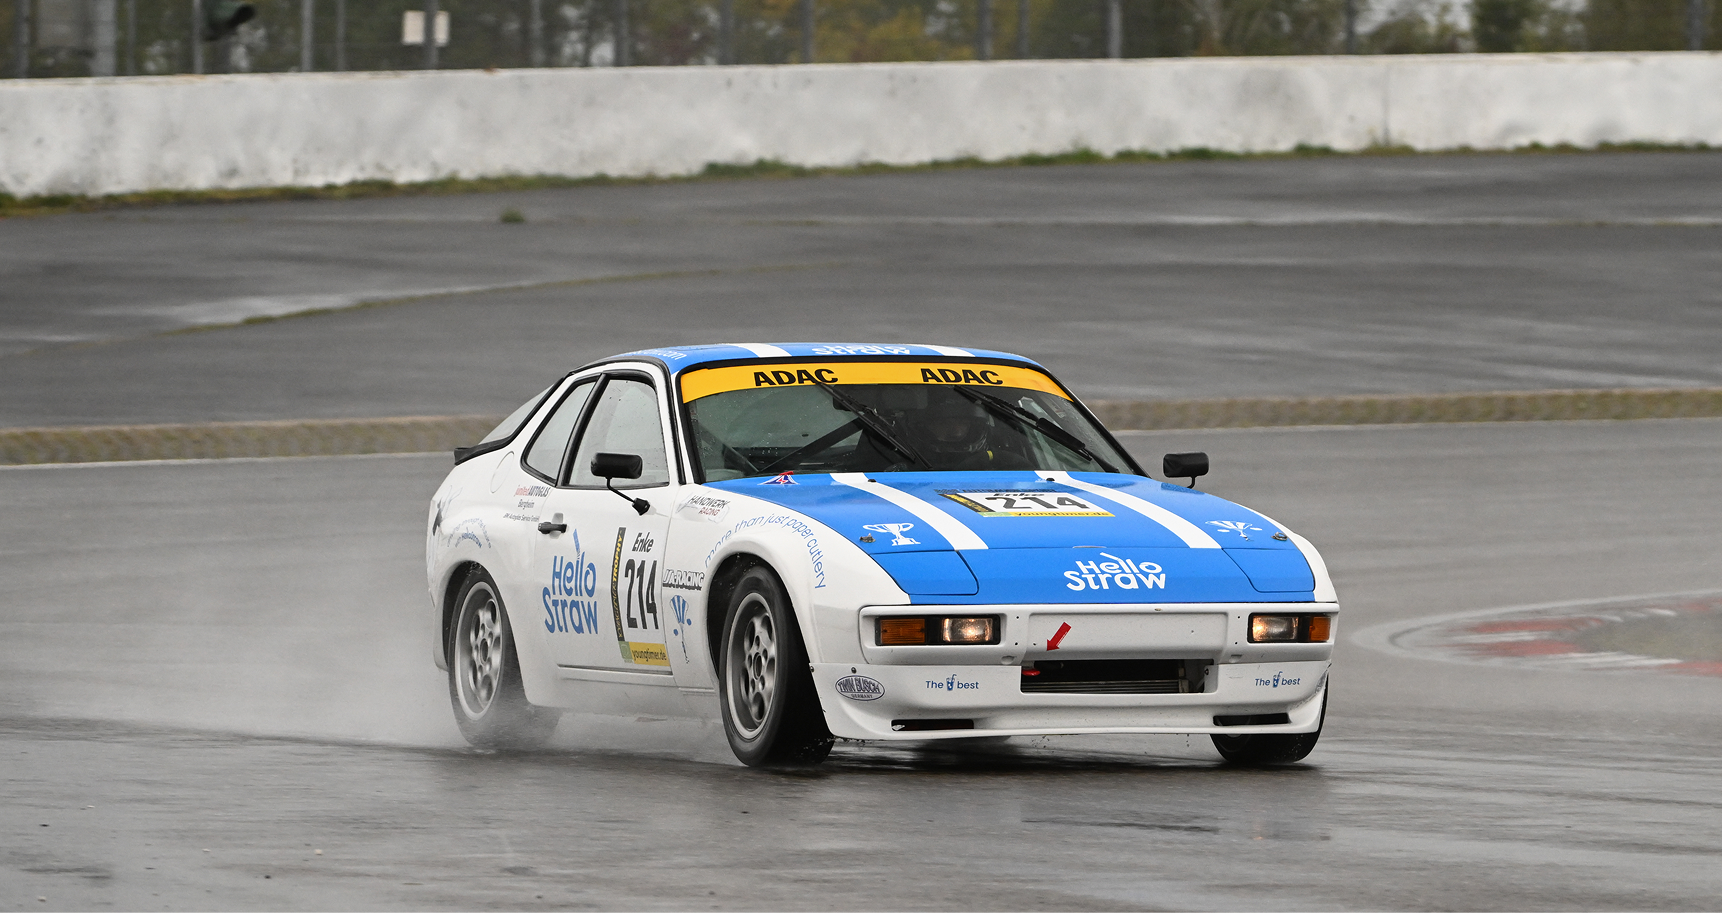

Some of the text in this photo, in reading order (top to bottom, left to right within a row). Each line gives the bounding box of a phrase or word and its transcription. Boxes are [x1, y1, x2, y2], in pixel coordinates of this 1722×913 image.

[754, 369, 838, 386] ADAC
[920, 368, 1004, 385] ADAC
[687, 495, 731, 509] HANDWERK
[984, 496, 1090, 509] 214
[698, 506, 721, 516] RACING
[632, 531, 655, 553] Enke
[704, 513, 826, 589] more than just paper cutlery
[551, 547, 597, 598] Hello
[1075, 554, 1163, 574] Hello
[1063, 570, 1166, 591] Straw
[624, 558, 659, 630] 214
[542, 586, 599, 635] Straw
[631, 648, 667, 662] youngtimer.de
[837, 677, 881, 693] TWIN BUSCH
[925, 680, 979, 690] The best
[1255, 677, 1301, 686] The best
